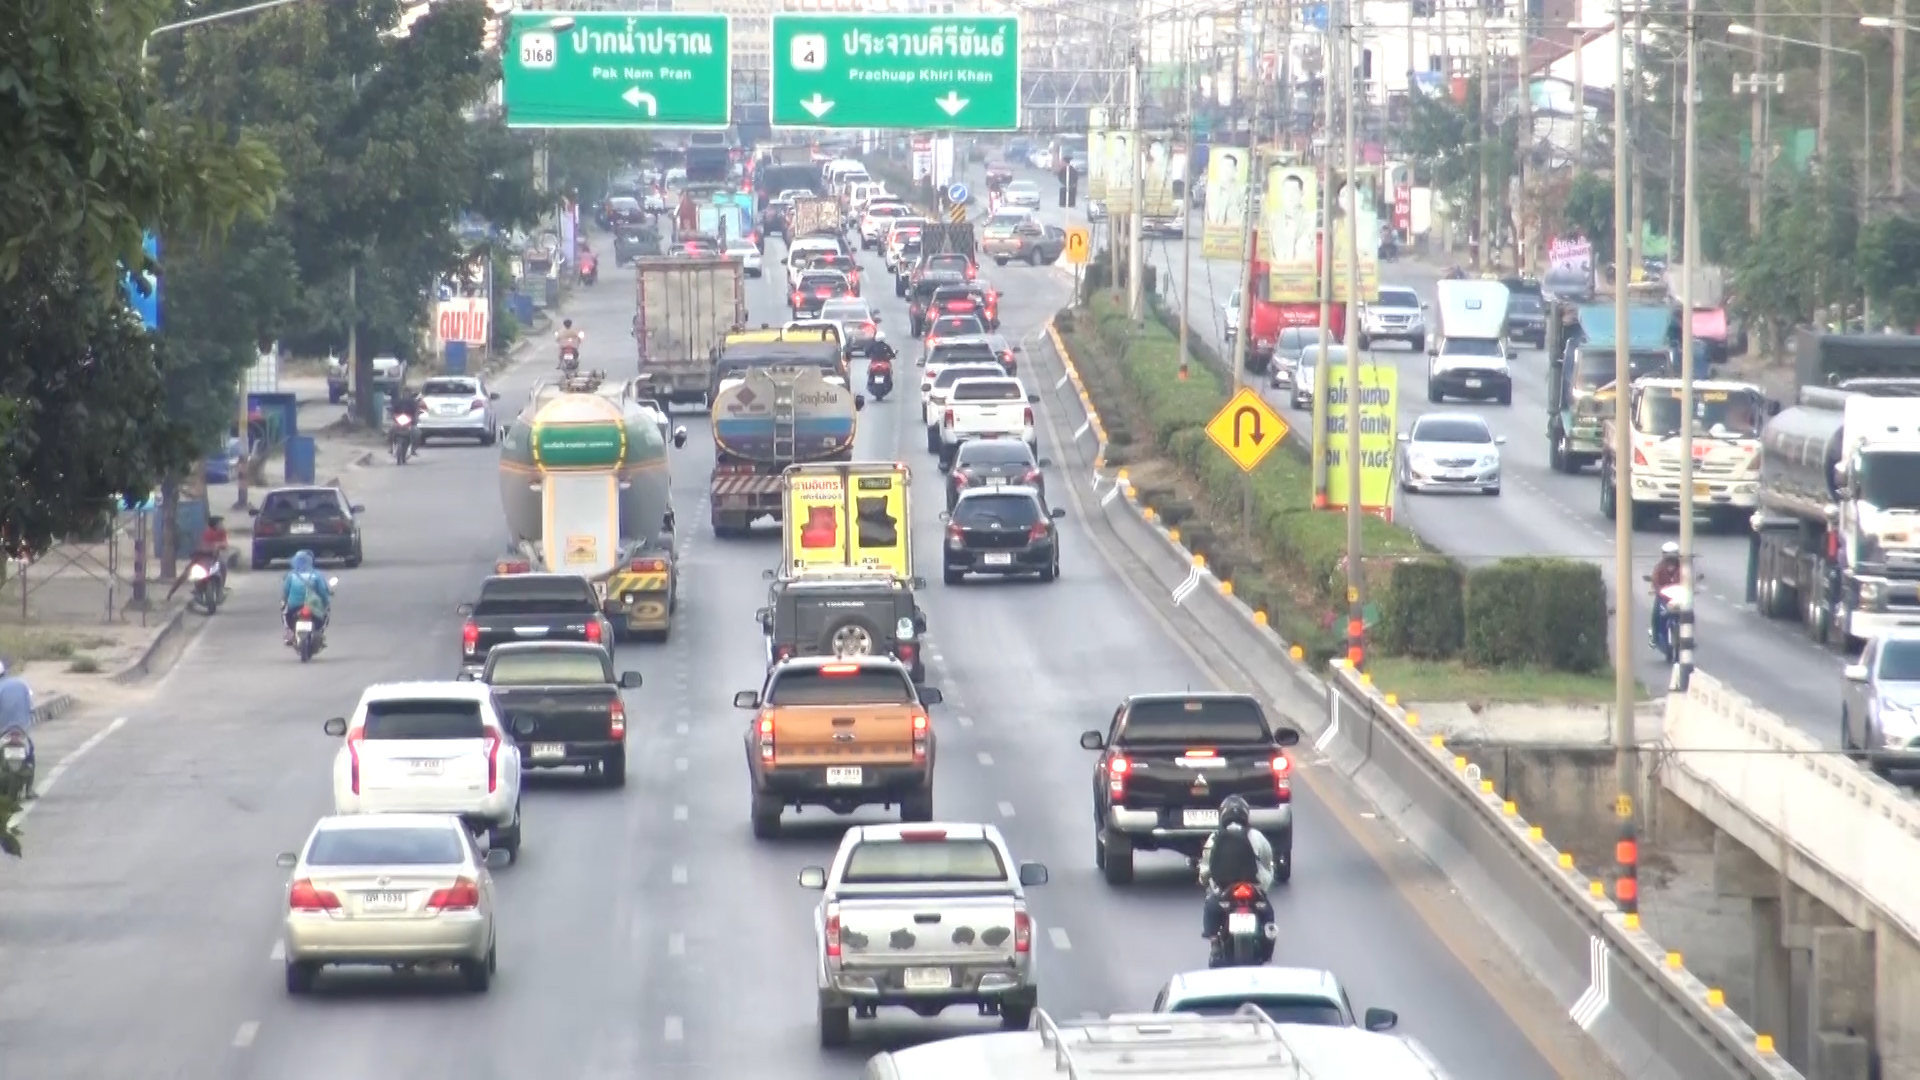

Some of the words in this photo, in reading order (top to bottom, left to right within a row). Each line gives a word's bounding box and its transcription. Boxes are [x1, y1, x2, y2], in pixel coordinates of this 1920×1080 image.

[571, 17, 713, 54] ปากน้ำปราณ
[843, 25, 1007, 56] ประจวบคีรีขันธ์
[523, 49, 553, 62] 3168
[803, 50, 815, 64] 4
[592, 67, 618, 79] Pak
[624, 67, 654, 79] Nam
[660, 67, 692, 79] Pran
[849, 68, 915, 83] Prachuap
[919, 68, 953, 82] Khiri
[957, 69, 993, 82] Khan
